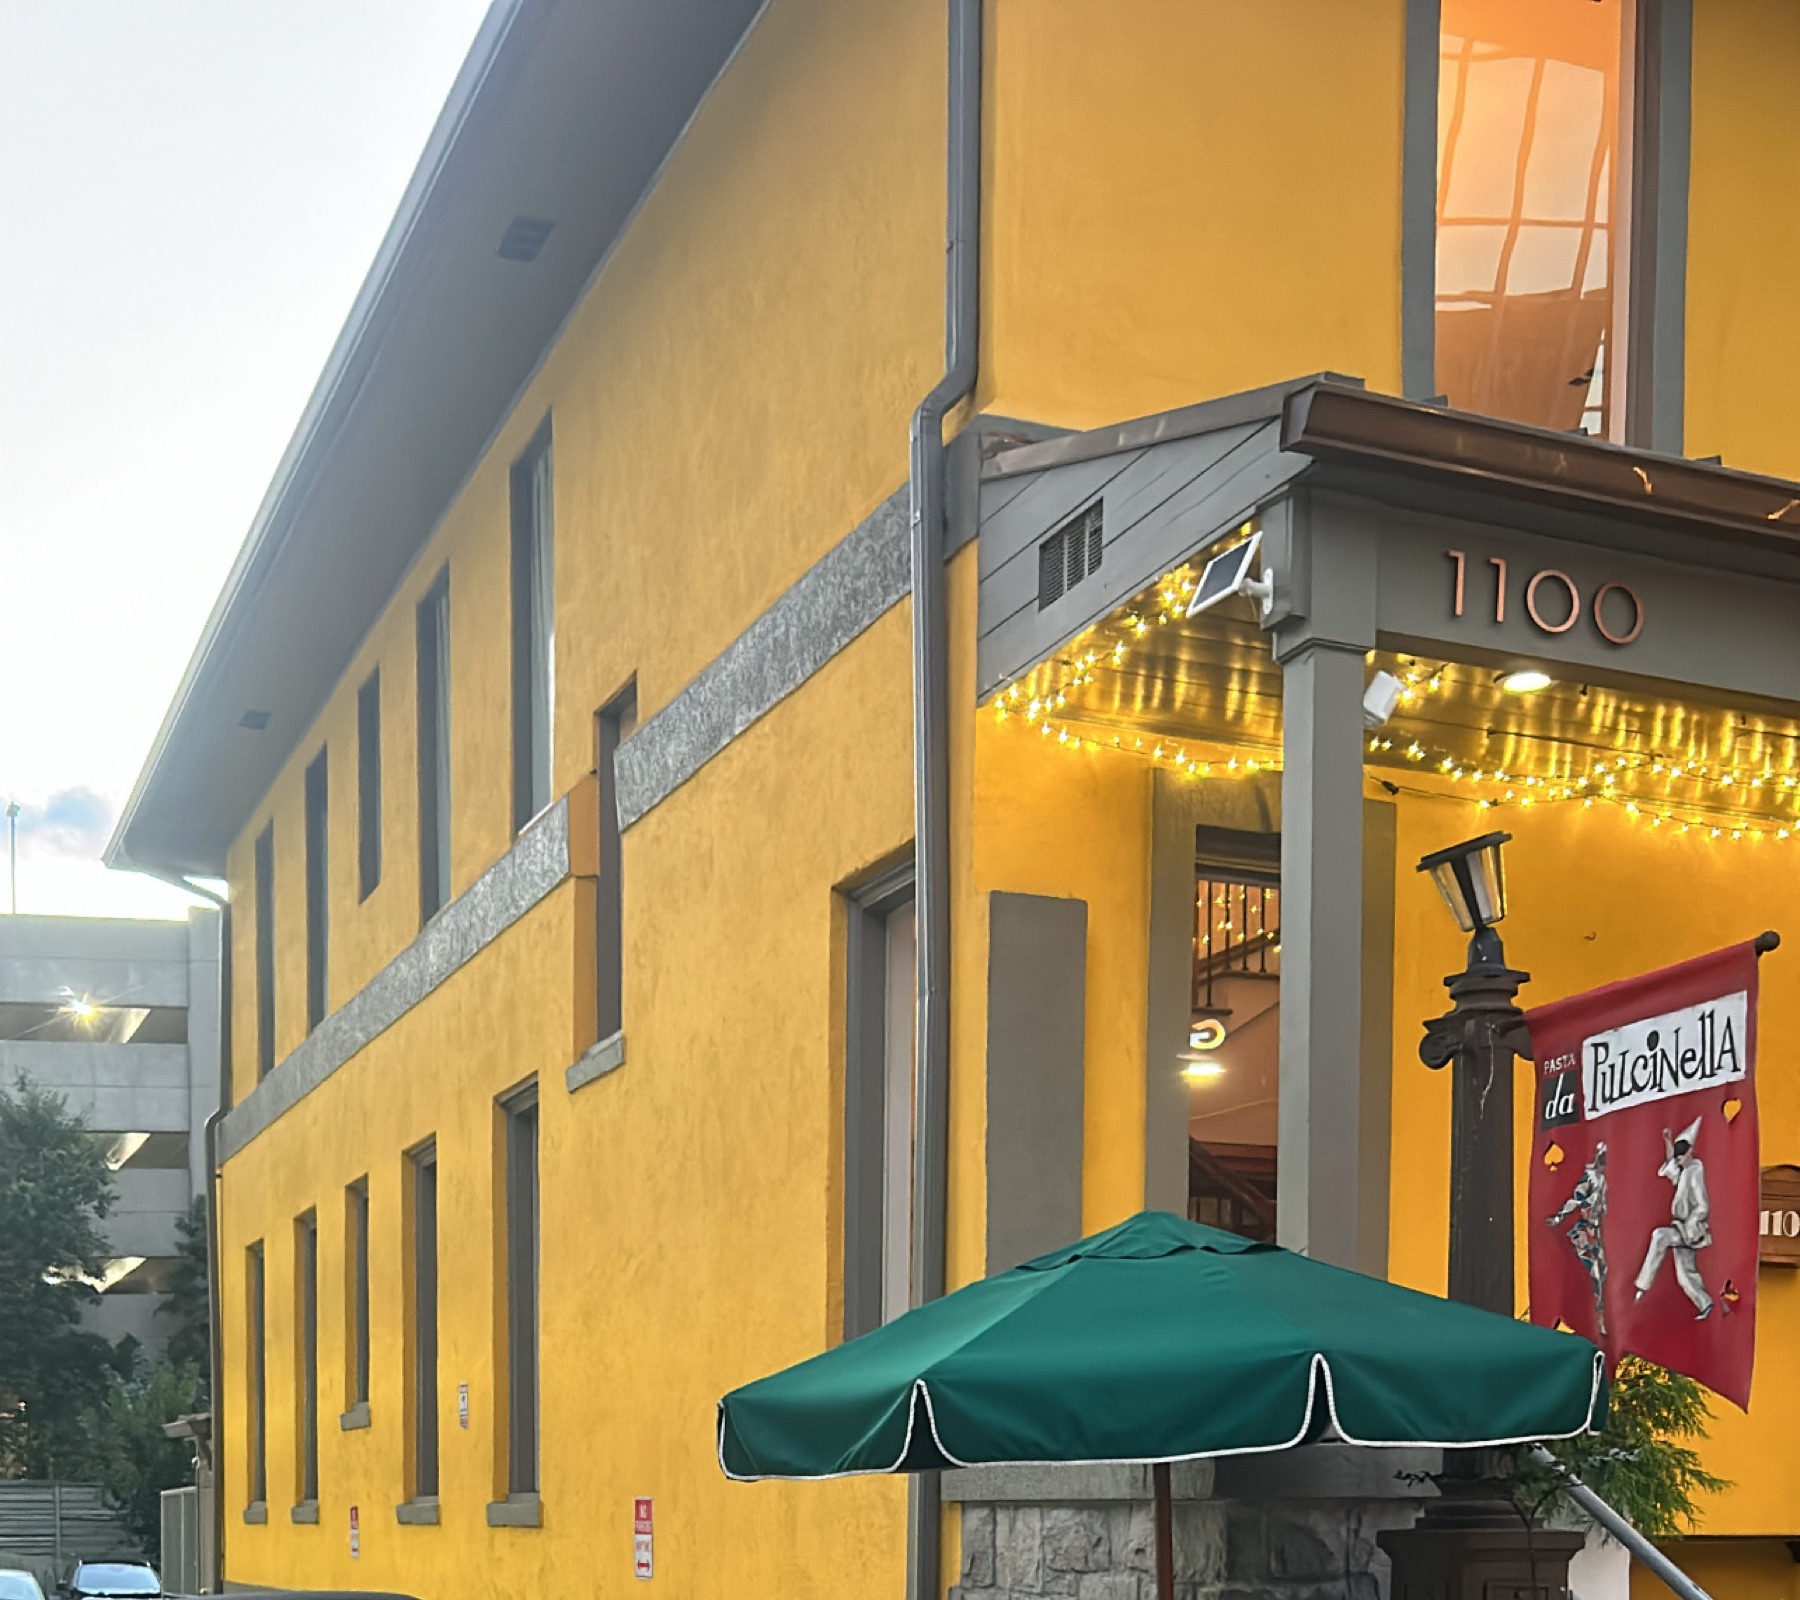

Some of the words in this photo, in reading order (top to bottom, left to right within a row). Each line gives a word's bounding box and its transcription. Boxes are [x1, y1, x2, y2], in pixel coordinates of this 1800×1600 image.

[1448, 550, 1643, 645] 1100
[1544, 1053, 1577, 1076] PASTA
[1545, 1072, 1575, 1120] da
